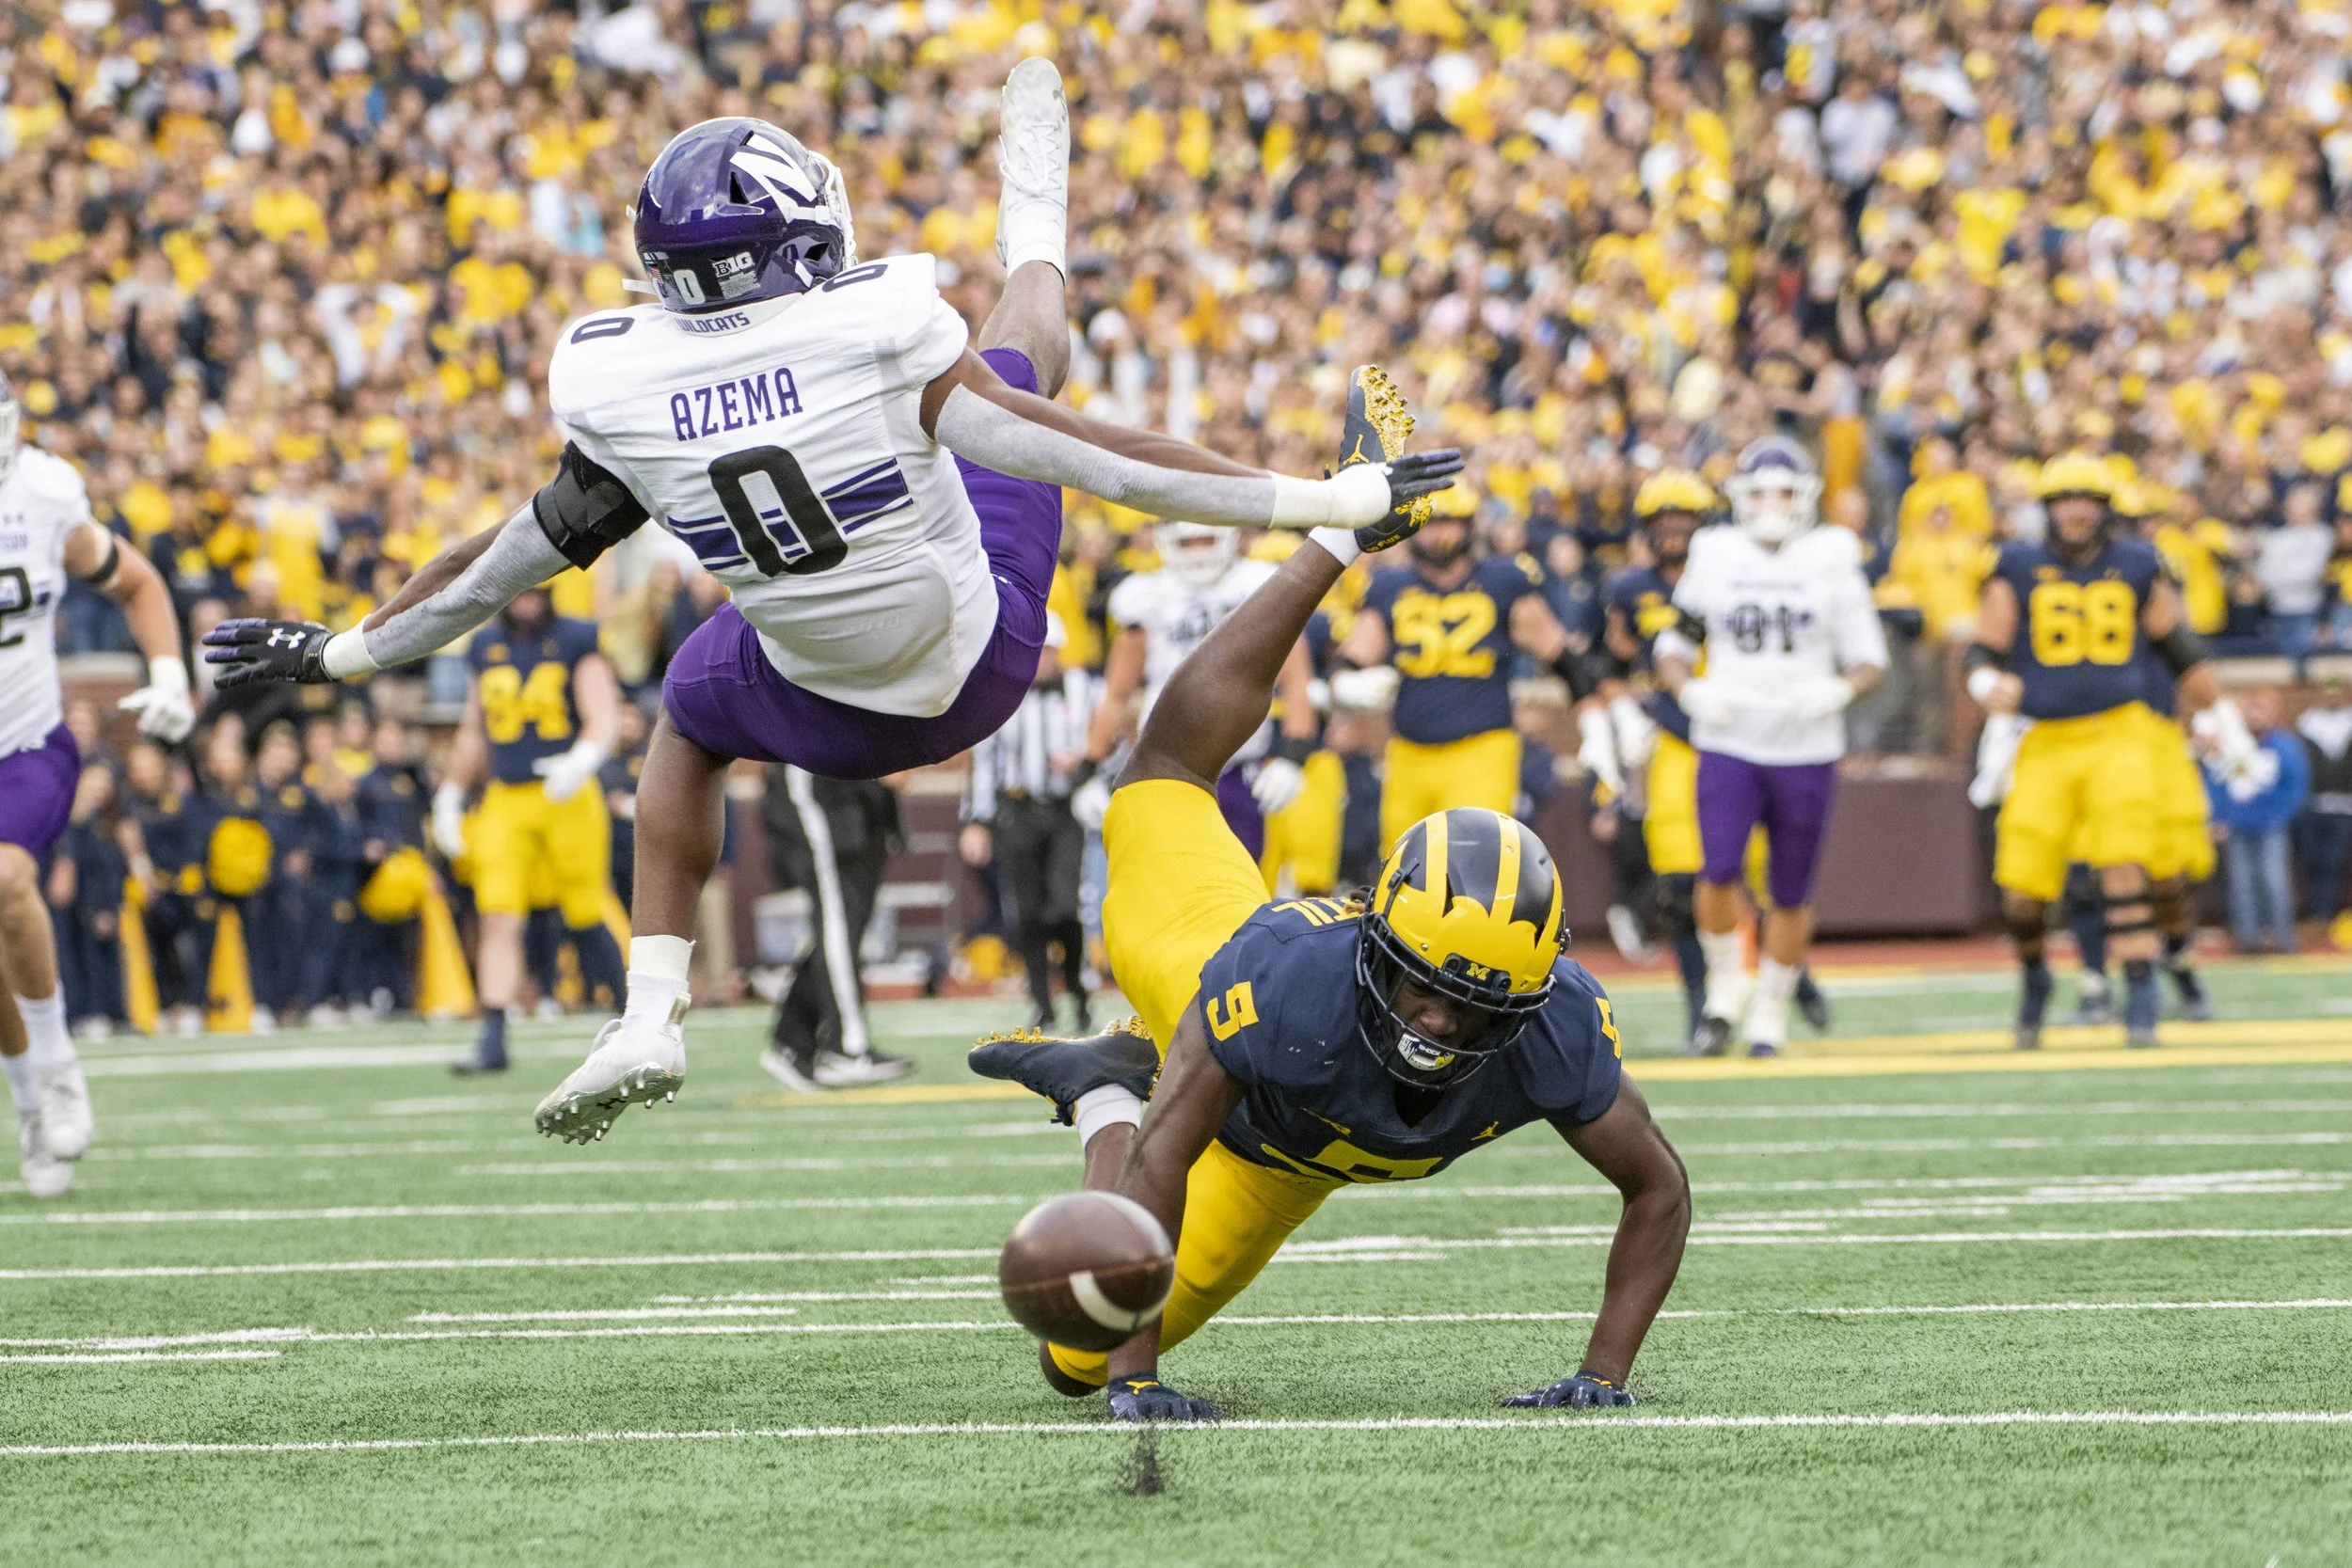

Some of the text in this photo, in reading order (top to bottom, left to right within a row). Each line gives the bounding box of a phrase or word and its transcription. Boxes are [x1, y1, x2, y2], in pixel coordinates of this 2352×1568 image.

[729, 134, 818, 224] N
[674, 269, 706, 305] 0
[822, 263, 888, 293] 0
[570, 317, 634, 344] 0
[674, 312, 751, 333] WILDCATS
[671, 368, 803, 442] AZEMA
[707, 445, 849, 577] 0
[2028, 580, 2137, 667] 68
[1466, 962, 1490, 981] M
